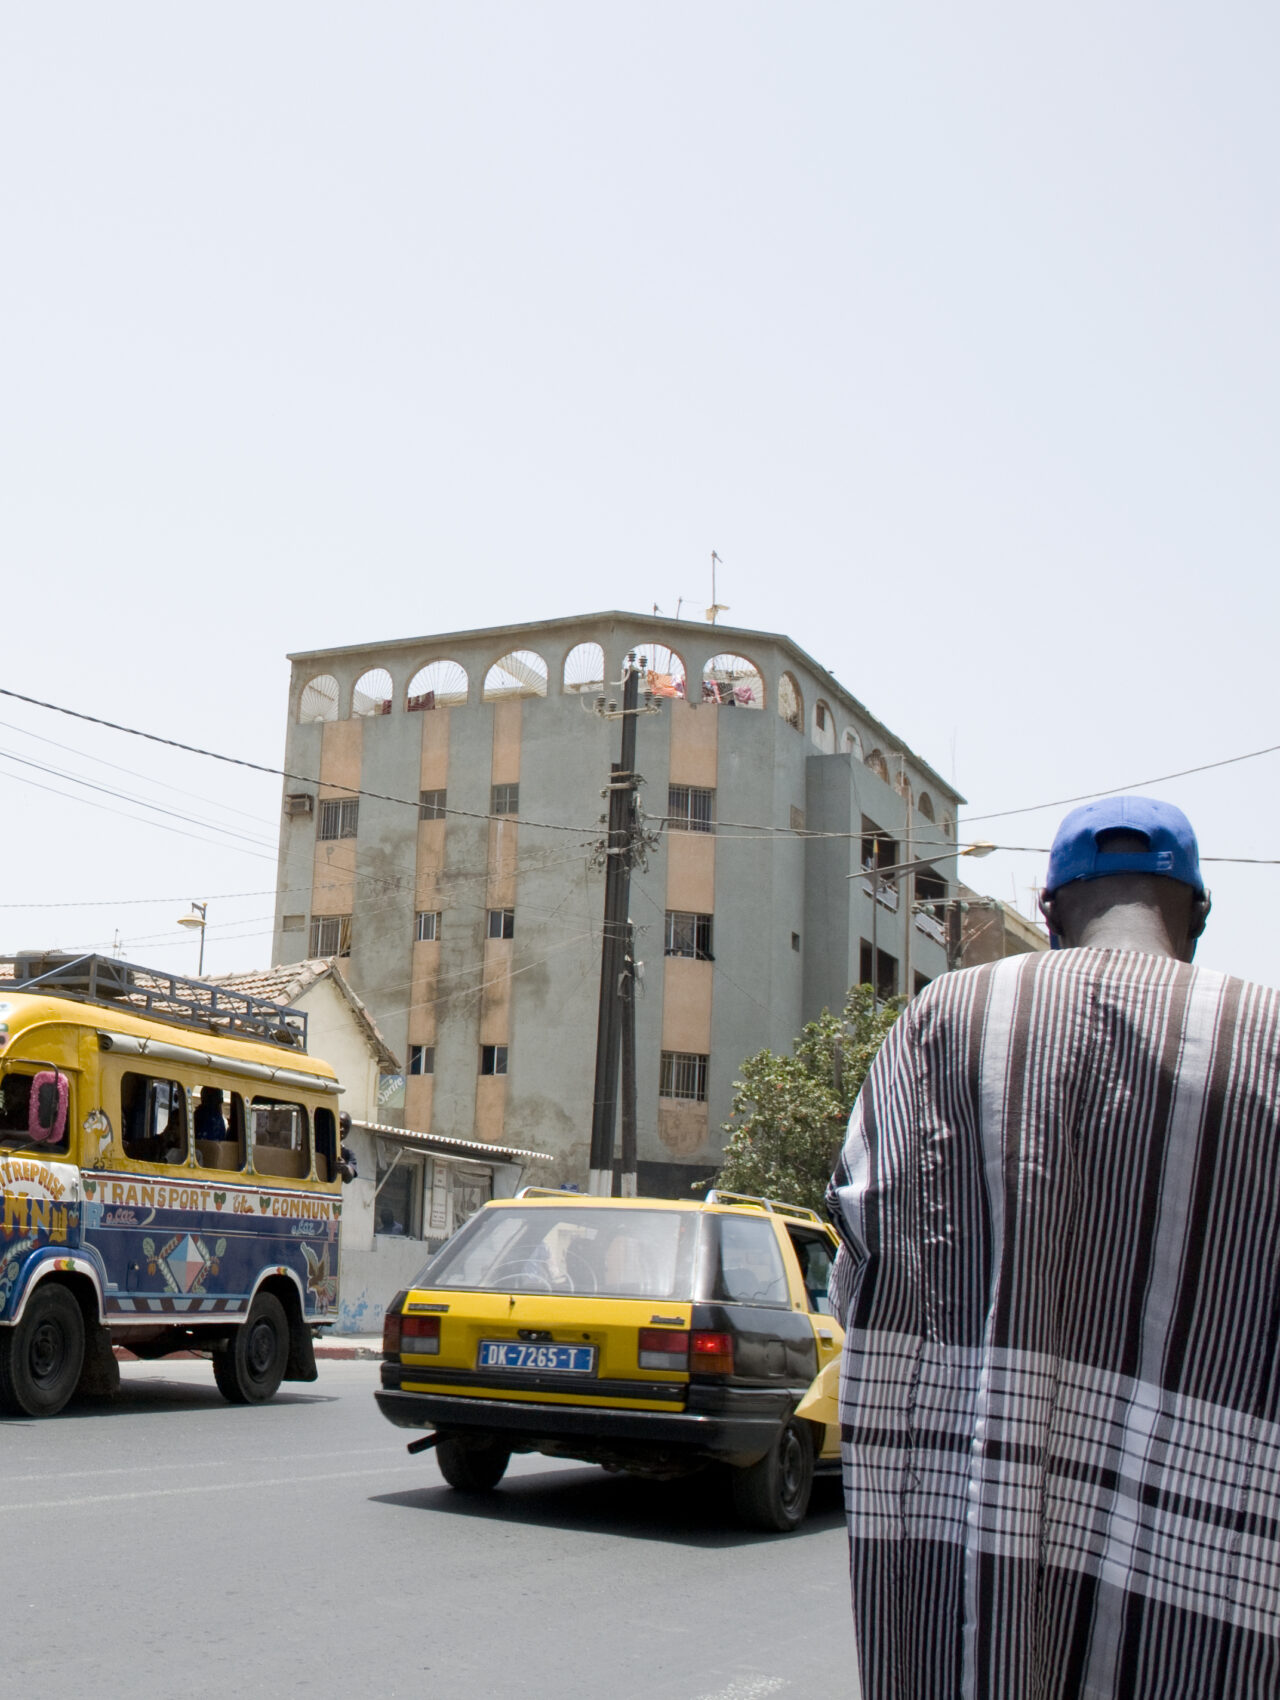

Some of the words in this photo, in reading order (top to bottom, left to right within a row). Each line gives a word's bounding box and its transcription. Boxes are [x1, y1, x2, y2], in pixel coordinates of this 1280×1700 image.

[378, 1077, 404, 1104] Sprite
[98, 1181, 210, 1211] TRANSPORT
[272, 1198, 330, 1221] COMMUN
[487, 1345, 578, 1370] DK-7265-T
